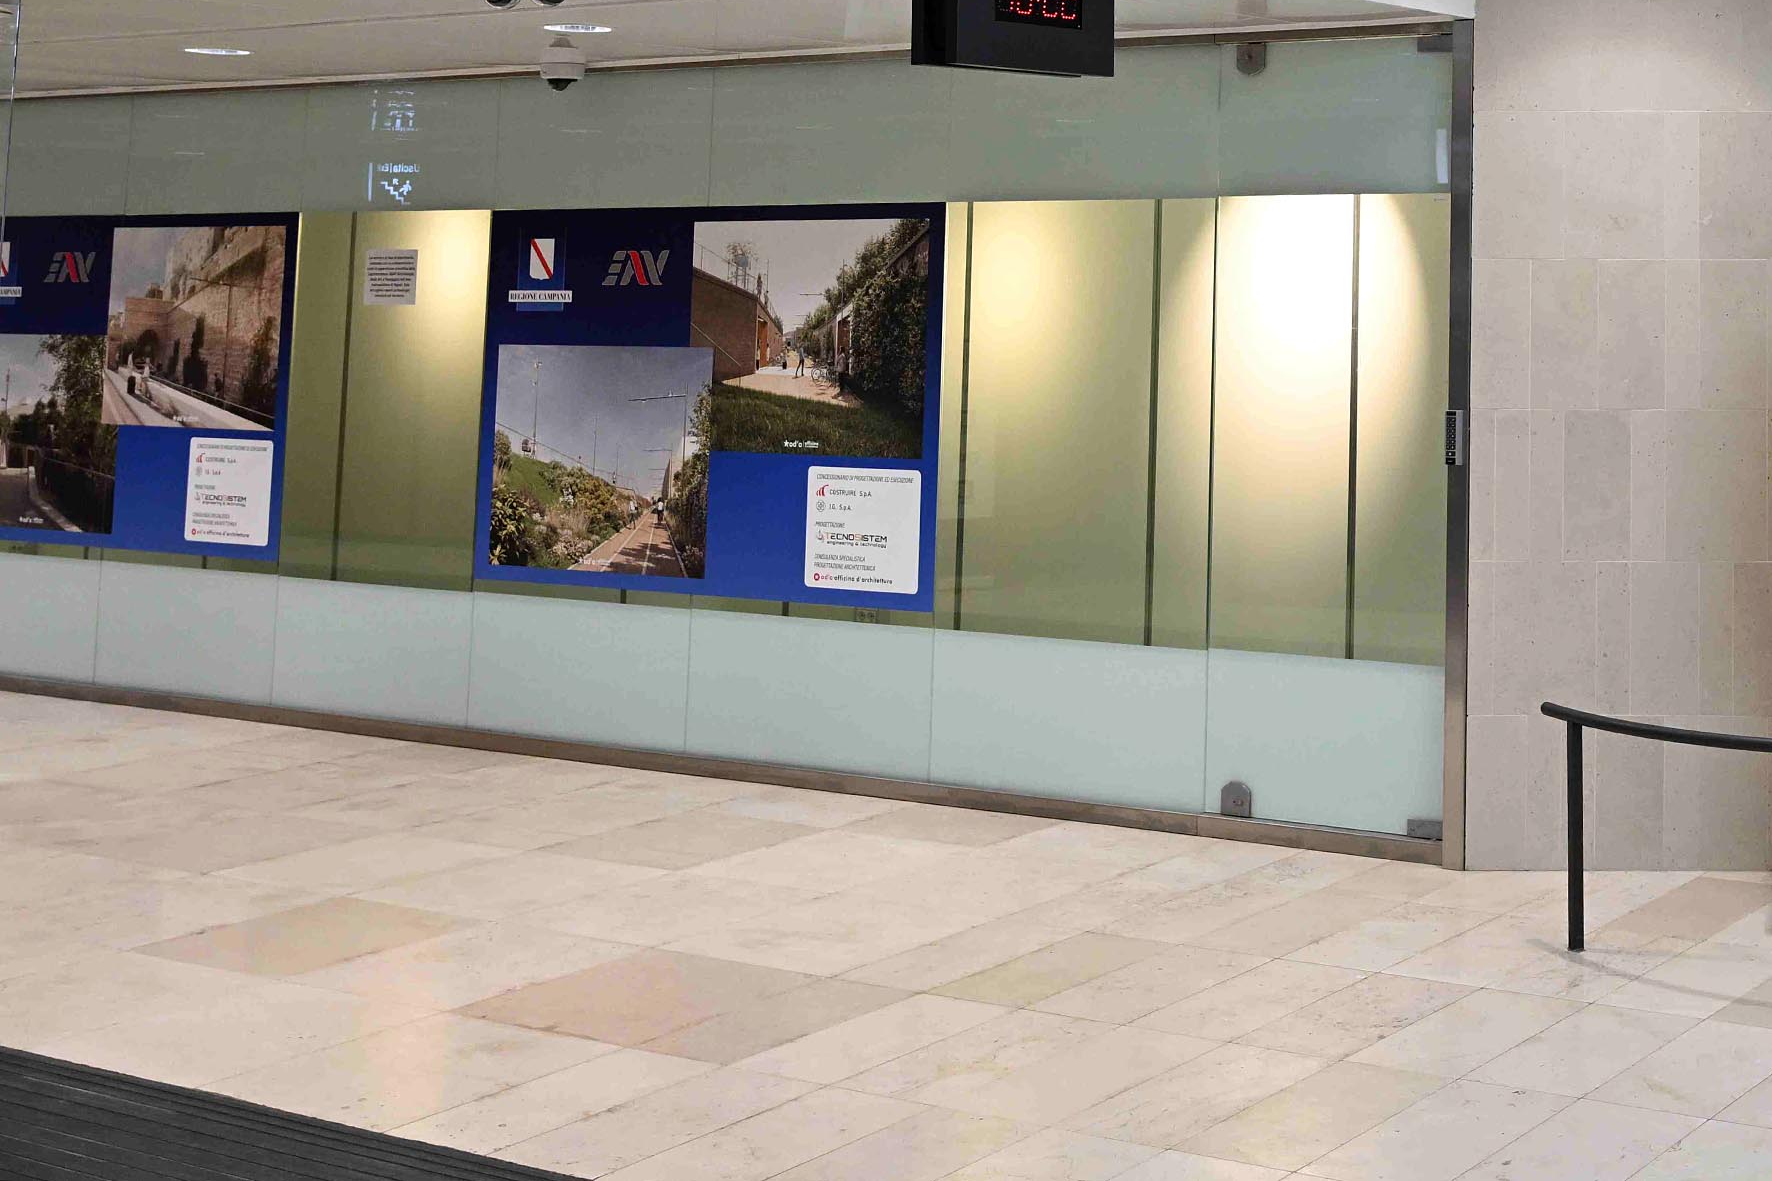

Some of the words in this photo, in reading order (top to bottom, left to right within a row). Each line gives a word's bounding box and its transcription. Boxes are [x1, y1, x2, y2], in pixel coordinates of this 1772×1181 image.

[510, 292, 537, 301] REGIONE
[538, 292, 571, 301] CAMPANIA
[829, 489, 856, 497] COSTRUIRE
[824, 531, 888, 543] TECNOSISTEM
[860, 541, 887, 549] technology
